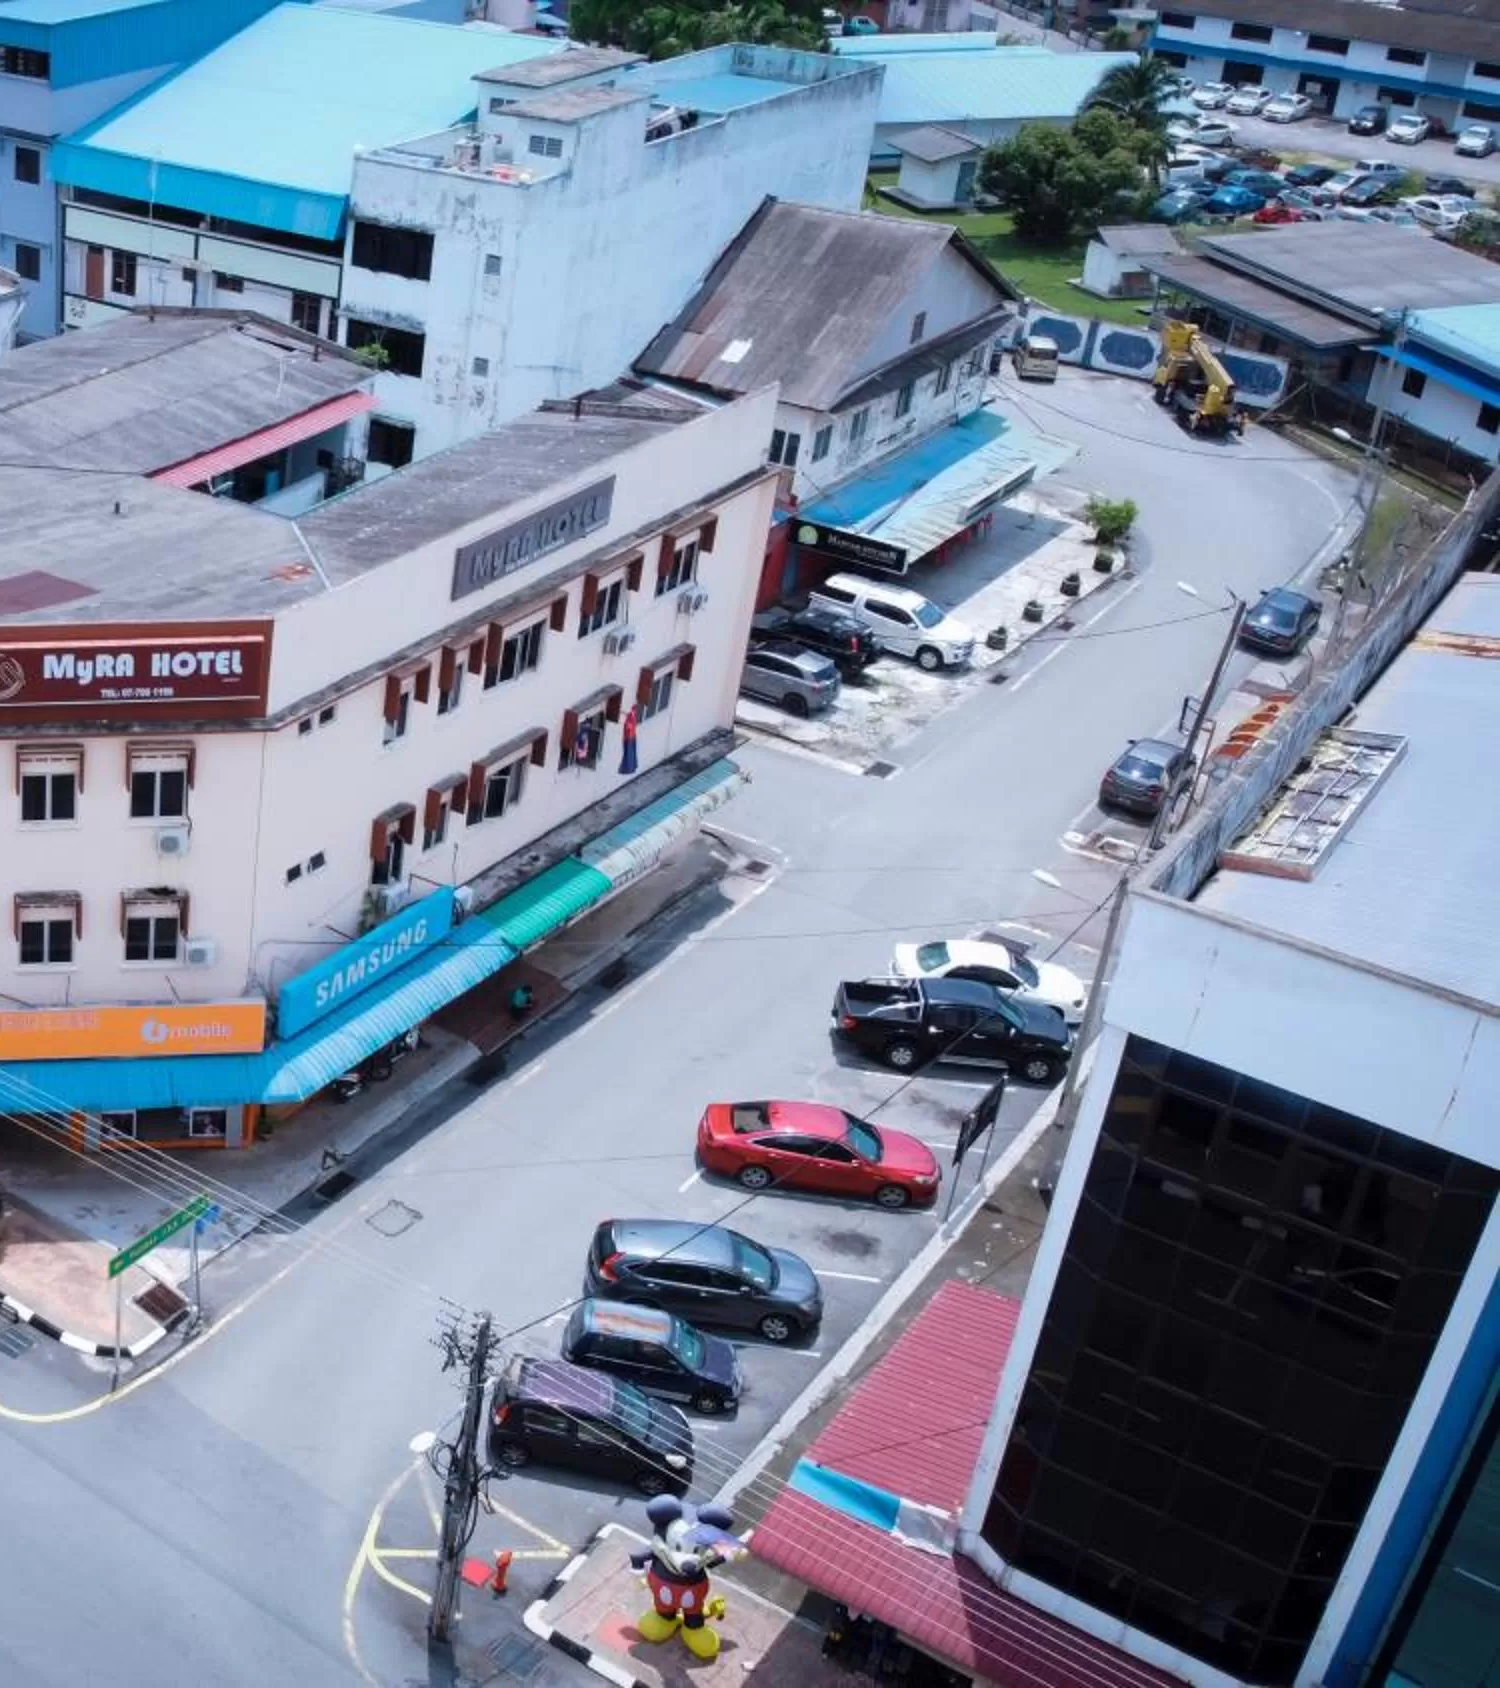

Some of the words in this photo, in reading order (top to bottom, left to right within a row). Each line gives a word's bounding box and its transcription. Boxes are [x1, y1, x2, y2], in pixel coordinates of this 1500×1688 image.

[43, 653, 135, 685] MyRA
[151, 650, 243, 677] HOTEL
[315, 918, 428, 1009] SAMSUNG
